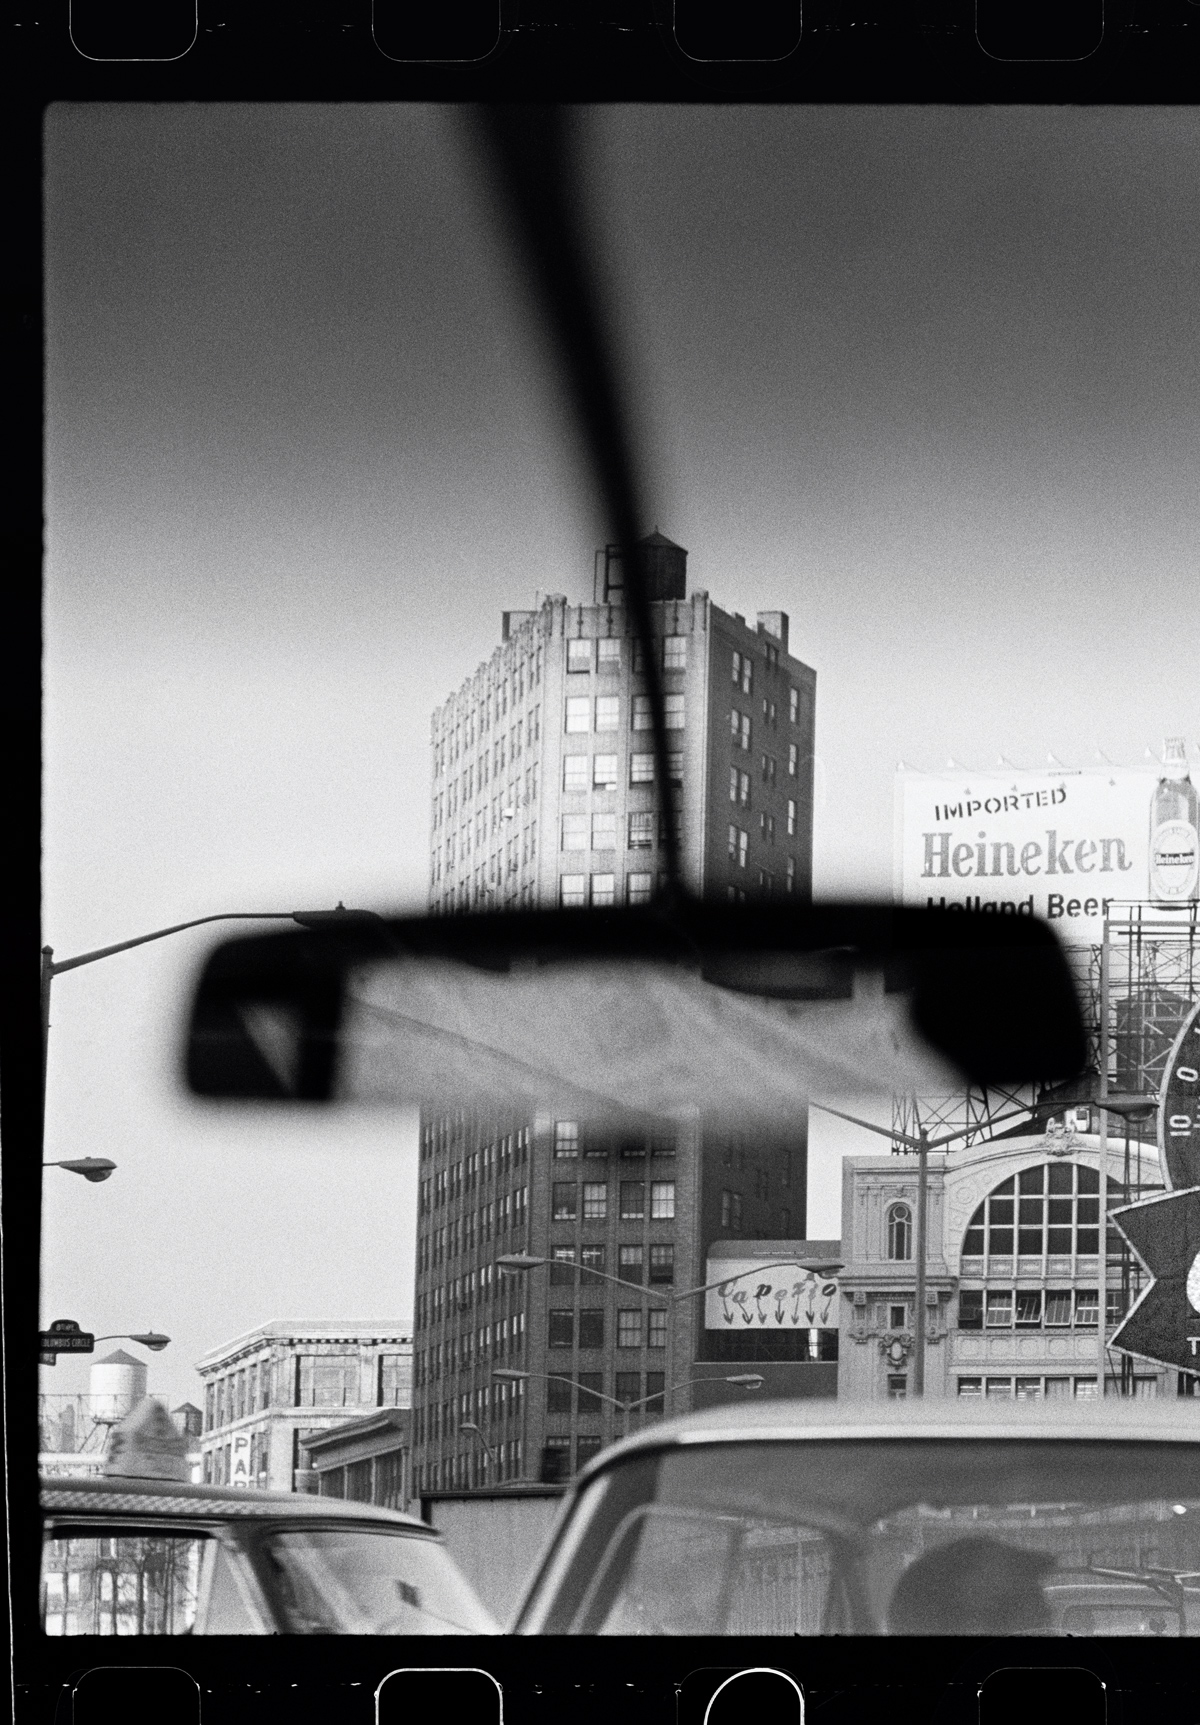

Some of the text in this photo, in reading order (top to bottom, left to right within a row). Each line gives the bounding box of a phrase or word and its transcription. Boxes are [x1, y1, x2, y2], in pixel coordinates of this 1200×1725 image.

[935, 788, 1066, 821] IMPORTED
[920, 830, 1133, 877] Heineken
[1047, 894, 1114, 919] Beer
[1176, 1066, 1199, 1082] 0
[1169, 1115, 1192, 1137] 10
[71, 1338, 91, 1348] CIRCLE
